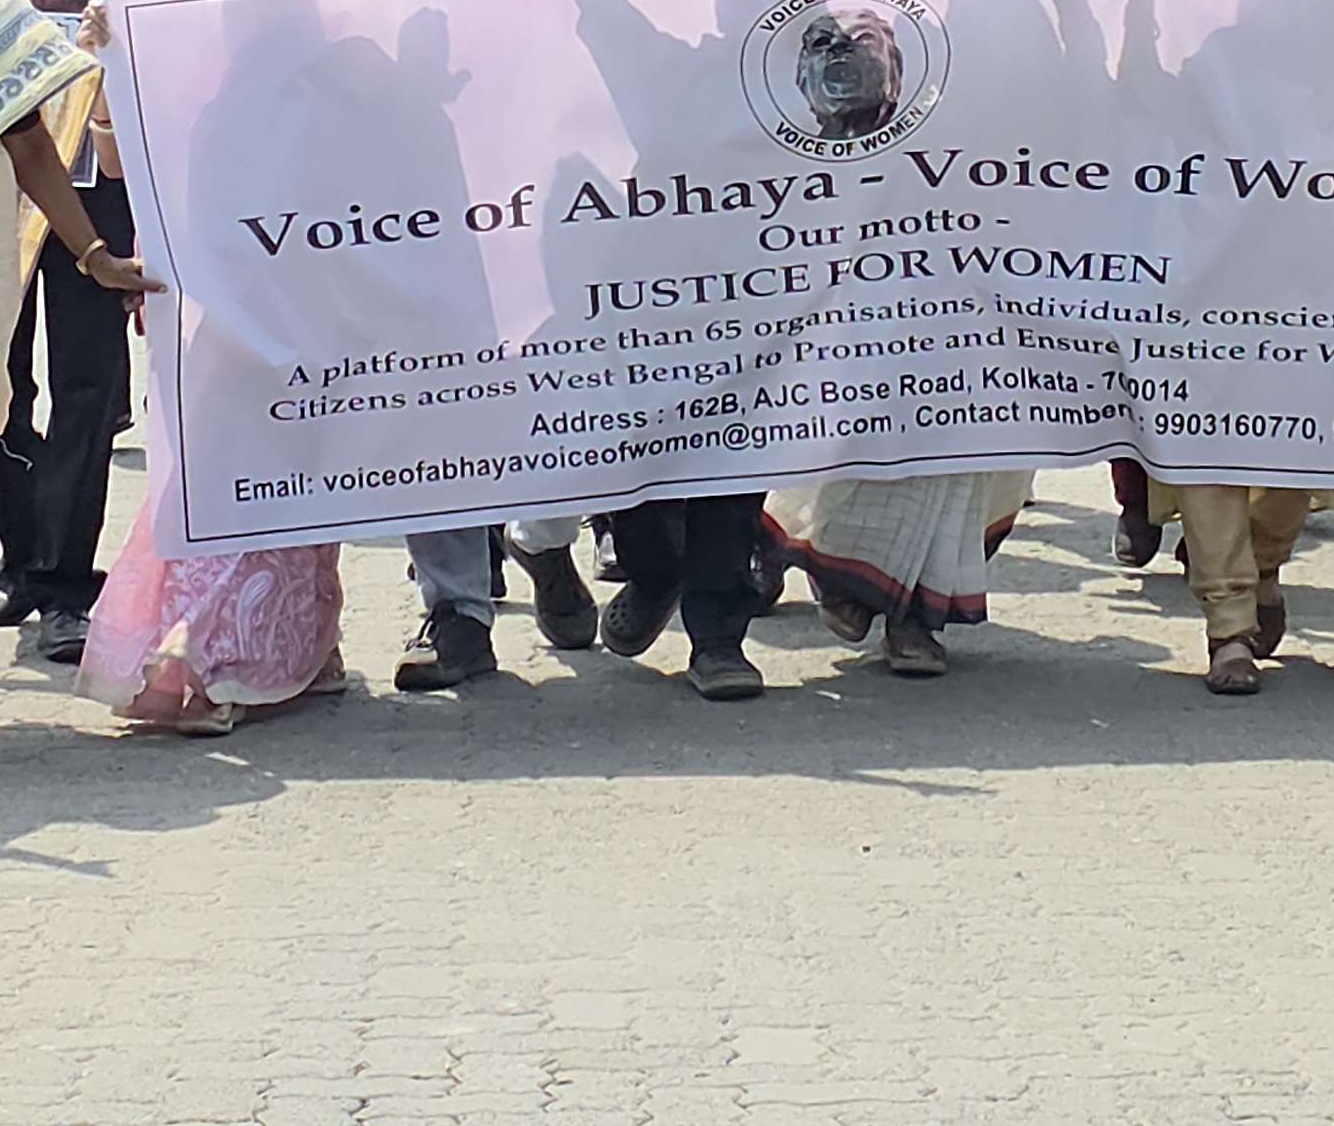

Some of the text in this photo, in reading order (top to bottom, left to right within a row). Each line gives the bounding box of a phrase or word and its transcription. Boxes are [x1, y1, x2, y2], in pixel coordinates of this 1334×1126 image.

[774, 105, 925, 157] VOICE OF WOMEN
[238, 204, 441, 256] Voice
[466, 184, 535, 232] of
[560, 171, 839, 223] Abhaya
[859, 175, 885, 185] -
[903, 147, 1110, 190] Voice
[1134, 153, 1205, 195] of
[758, 224, 845, 252] Our
[858, 209, 982, 242] motto
[584, 246, 1172, 320] JUSTICE FOR WOMEN
[269, 393, 407, 421] Citizens
[417, 379, 518, 407] across
[527, 368, 616, 393] West
[626, 354, 743, 386] Bengal
[755, 351, 782, 370] to
[794, 334, 935, 363] Promote
[945, 326, 1005, 349] and
[1017, 328, 1120, 354] Ensure
[1129, 337, 1246, 363] Justice
[1257, 339, 1308, 363] for
[286, 365, 310, 387] A
[321, 351, 465, 389] platform
[476, 340, 510, 364] of
[520, 335, 606, 359] more
[618, 327, 695, 350] than
[705, 319, 742, 342] 65
[753, 296, 985, 337] organisations,
[995, 293, 1190, 328] individuals,
[530, 409, 648, 438] Address
[674, 392, 746, 420] 162B,
[753, 383, 810, 410] AJC
[820, 381, 891, 404] Bose
[899, 368, 972, 397] Road,
[982, 366, 1079, 394] Kolkata
[234, 472, 314, 502] Email:
[916, 400, 1021, 427] Contact
[1154, 412, 1324, 445] 9903160770,
